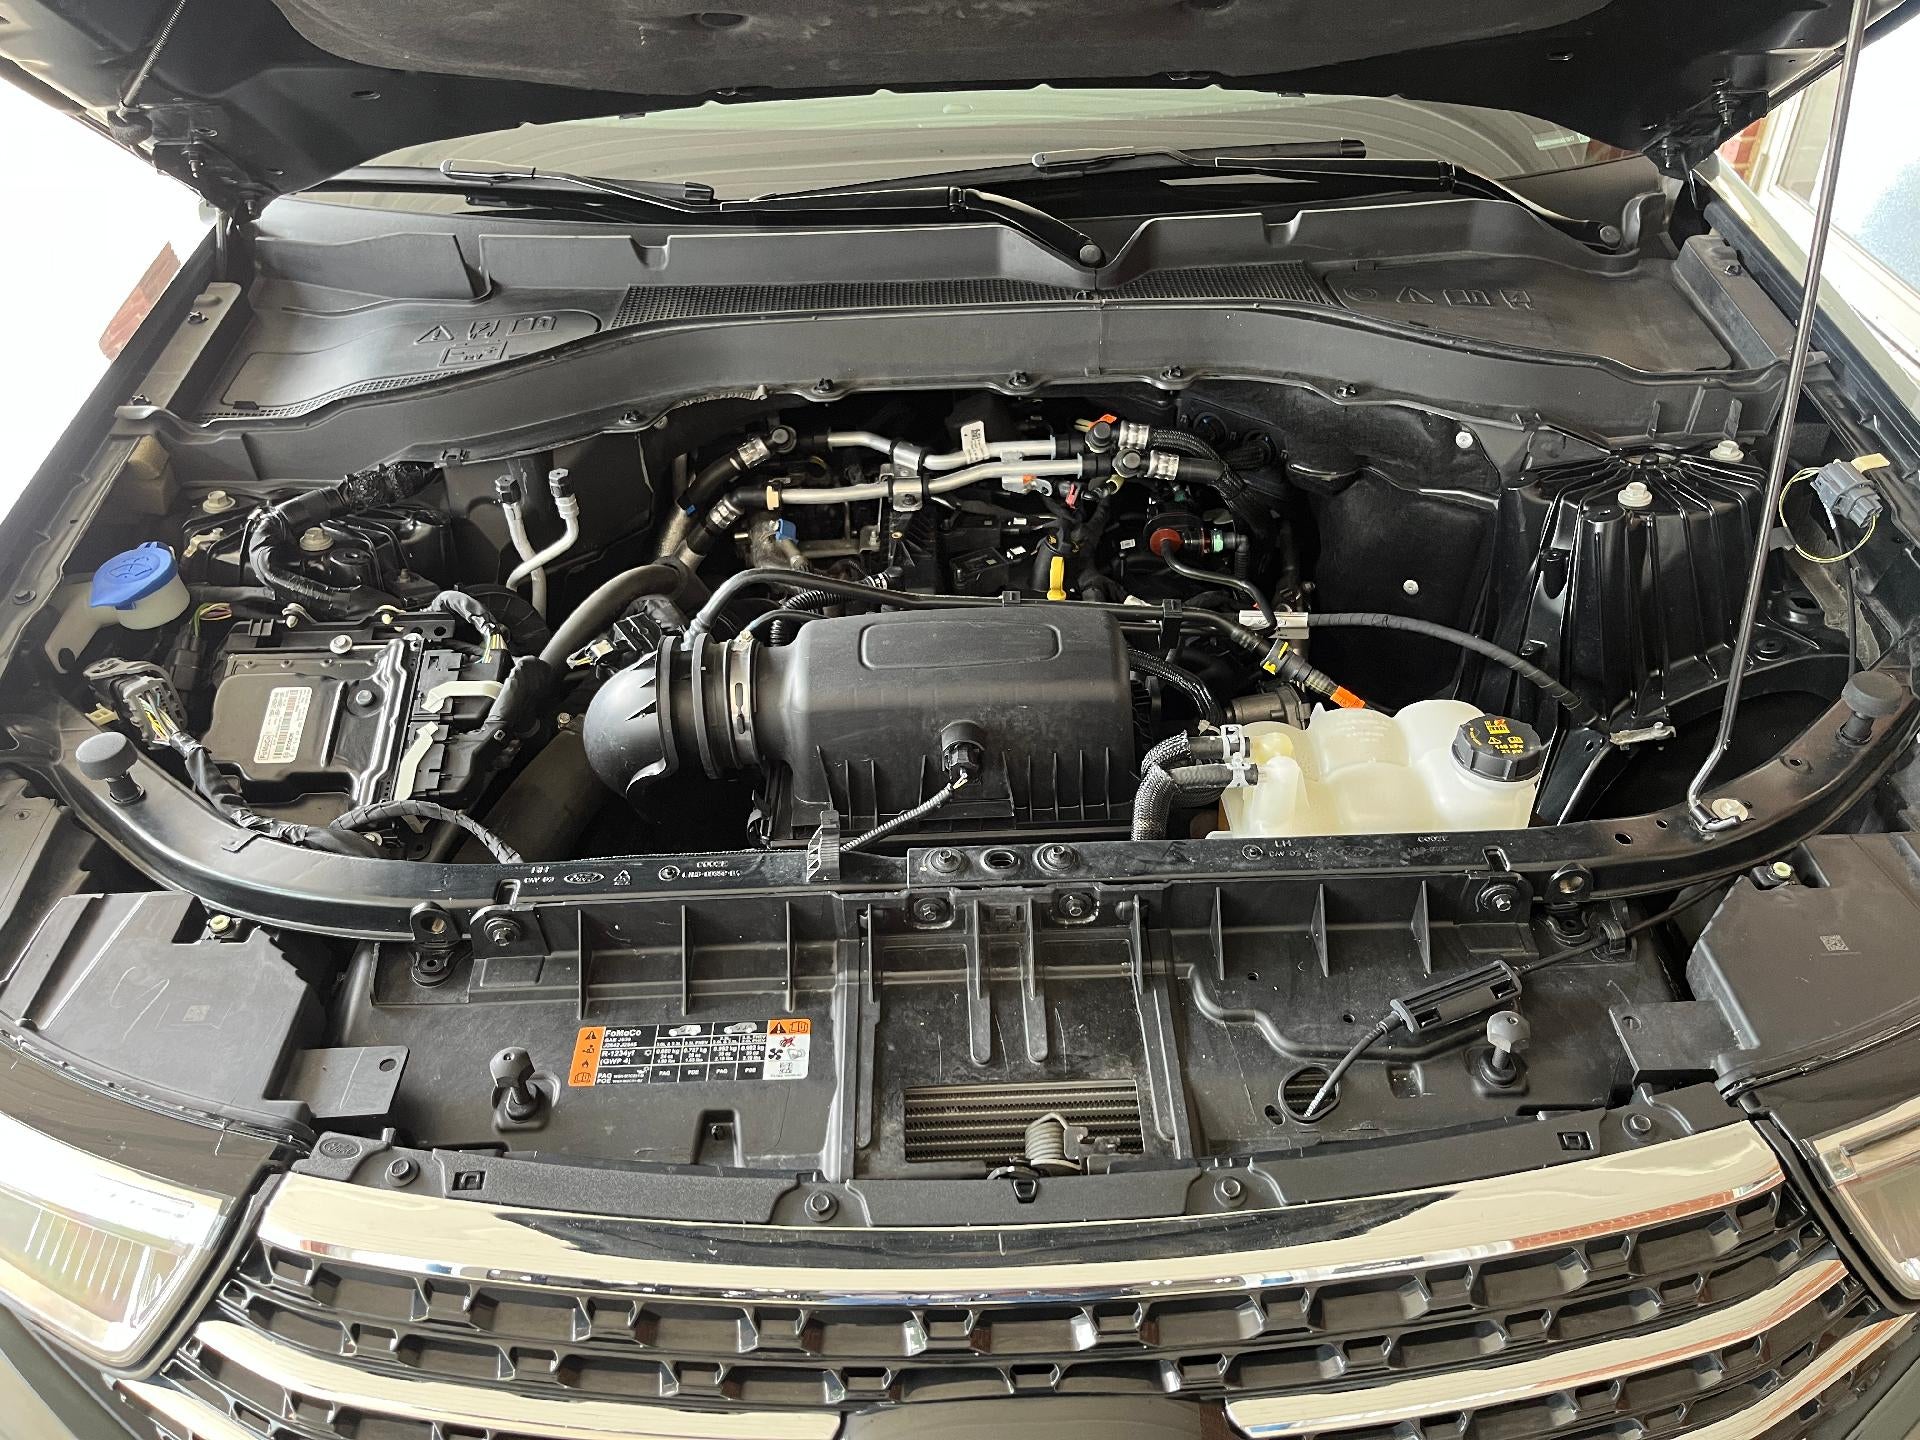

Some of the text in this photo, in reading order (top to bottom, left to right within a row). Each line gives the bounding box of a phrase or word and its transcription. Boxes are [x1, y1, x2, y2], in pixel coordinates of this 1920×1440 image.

[605, 1029, 642, 1037] FoMoCo
[601, 1049, 636, 1057] R-1234yf
[600, 1058, 623, 1066] (GWP
